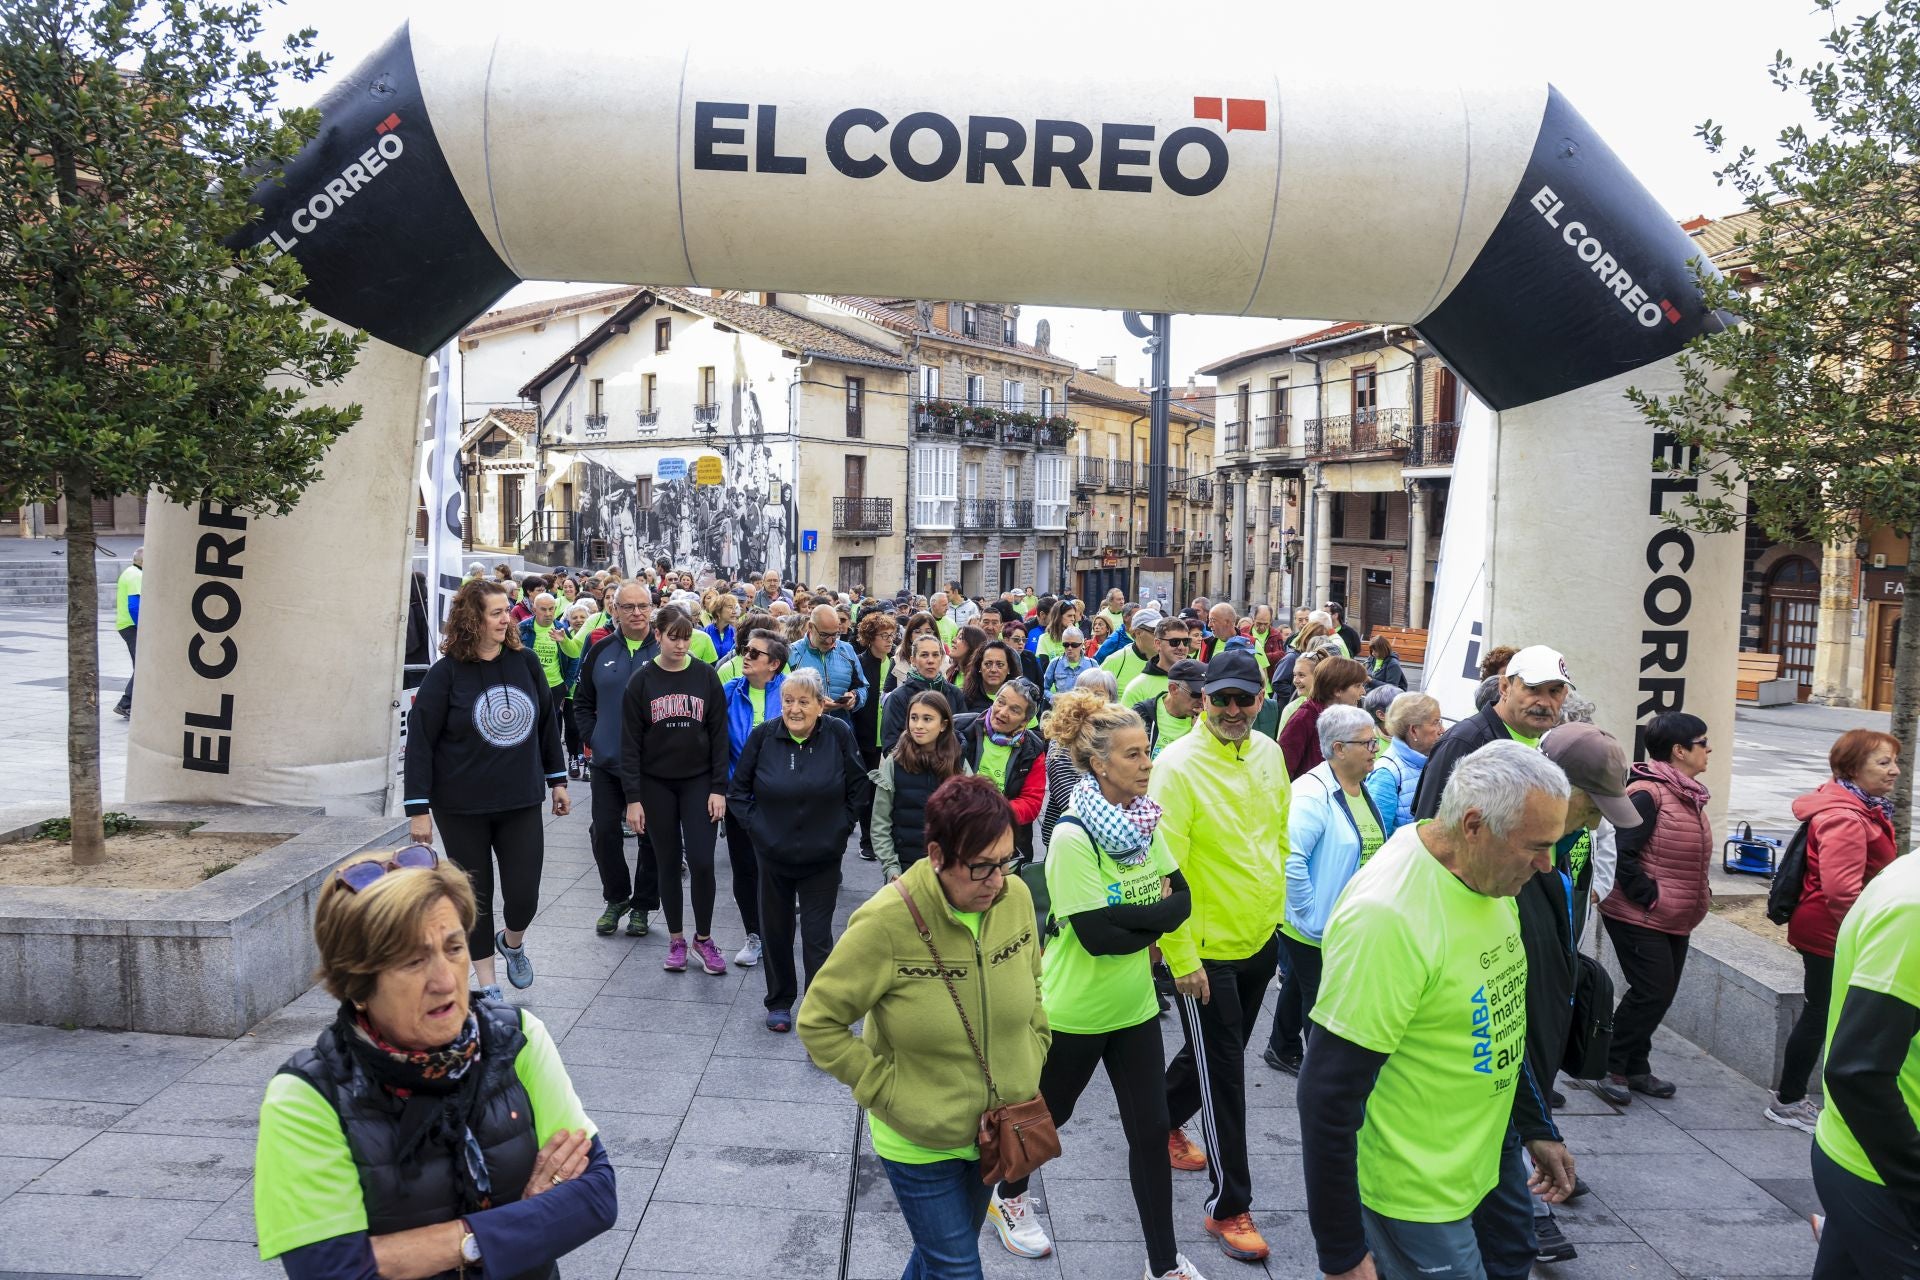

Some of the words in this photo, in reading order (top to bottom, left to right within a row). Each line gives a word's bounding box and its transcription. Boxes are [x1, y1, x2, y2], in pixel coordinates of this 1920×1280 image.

[291, 133, 404, 234] CORREO
[694, 101, 807, 175] EL
[825, 107, 1230, 197] CORREO
[1529, 184, 1565, 229] EL
[1562, 221, 1663, 328] CORREO
[1649, 432, 1700, 516] EL
[182, 692, 235, 775] EL
[650, 693, 705, 724] BROOKLYN
[1124, 886, 1136, 900] el
[1138, 880, 1160, 896] cánce
[1486, 979, 1496, 990] En
[1496, 964, 1516, 983] marcha
[1490, 985, 1501, 1007] el
[1471, 985, 1493, 1074] ARABA
[998, 1204, 1016, 1231] HOKA
